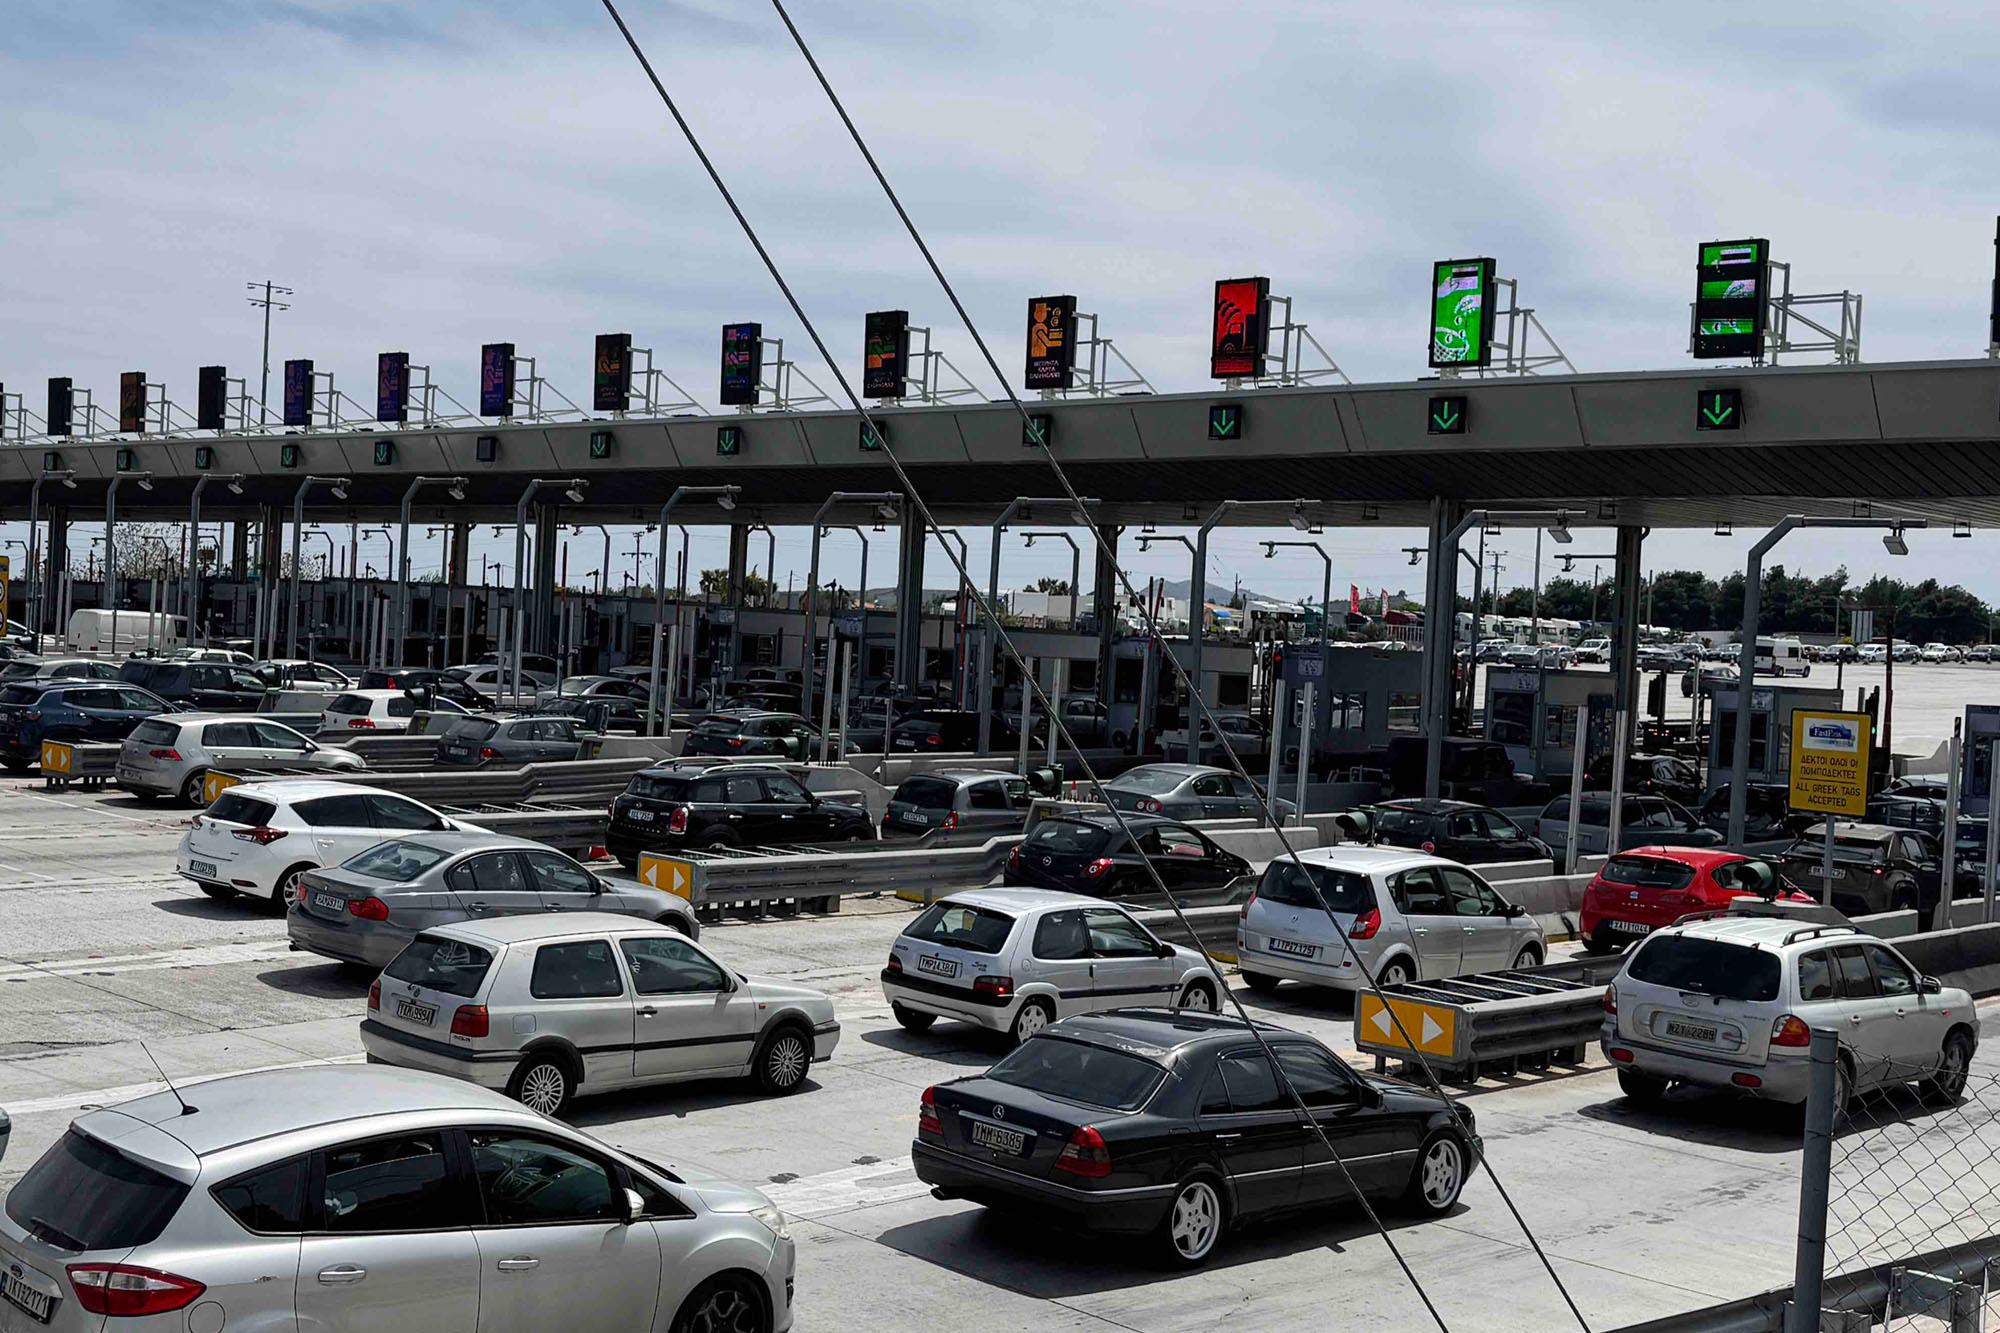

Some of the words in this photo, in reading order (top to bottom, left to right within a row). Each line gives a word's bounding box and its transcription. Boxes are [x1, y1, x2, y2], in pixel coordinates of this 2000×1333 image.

[1801, 755, 1827, 765] ΔΕΚΤΟΙ
[1830, 757, 1847, 767] ΟΛΟΙ
[1850, 759, 1858, 768] ΟΙ
[1801, 766, 1857, 779] ΠΟΜΠΟΔΕΚΤΕΣ
[1796, 782, 1809, 792] ALL
[1813, 784, 1837, 794] GREEK
[1842, 786, 1860, 797] TAGS
[1808, 795, 1847, 807] ACCEPTED
